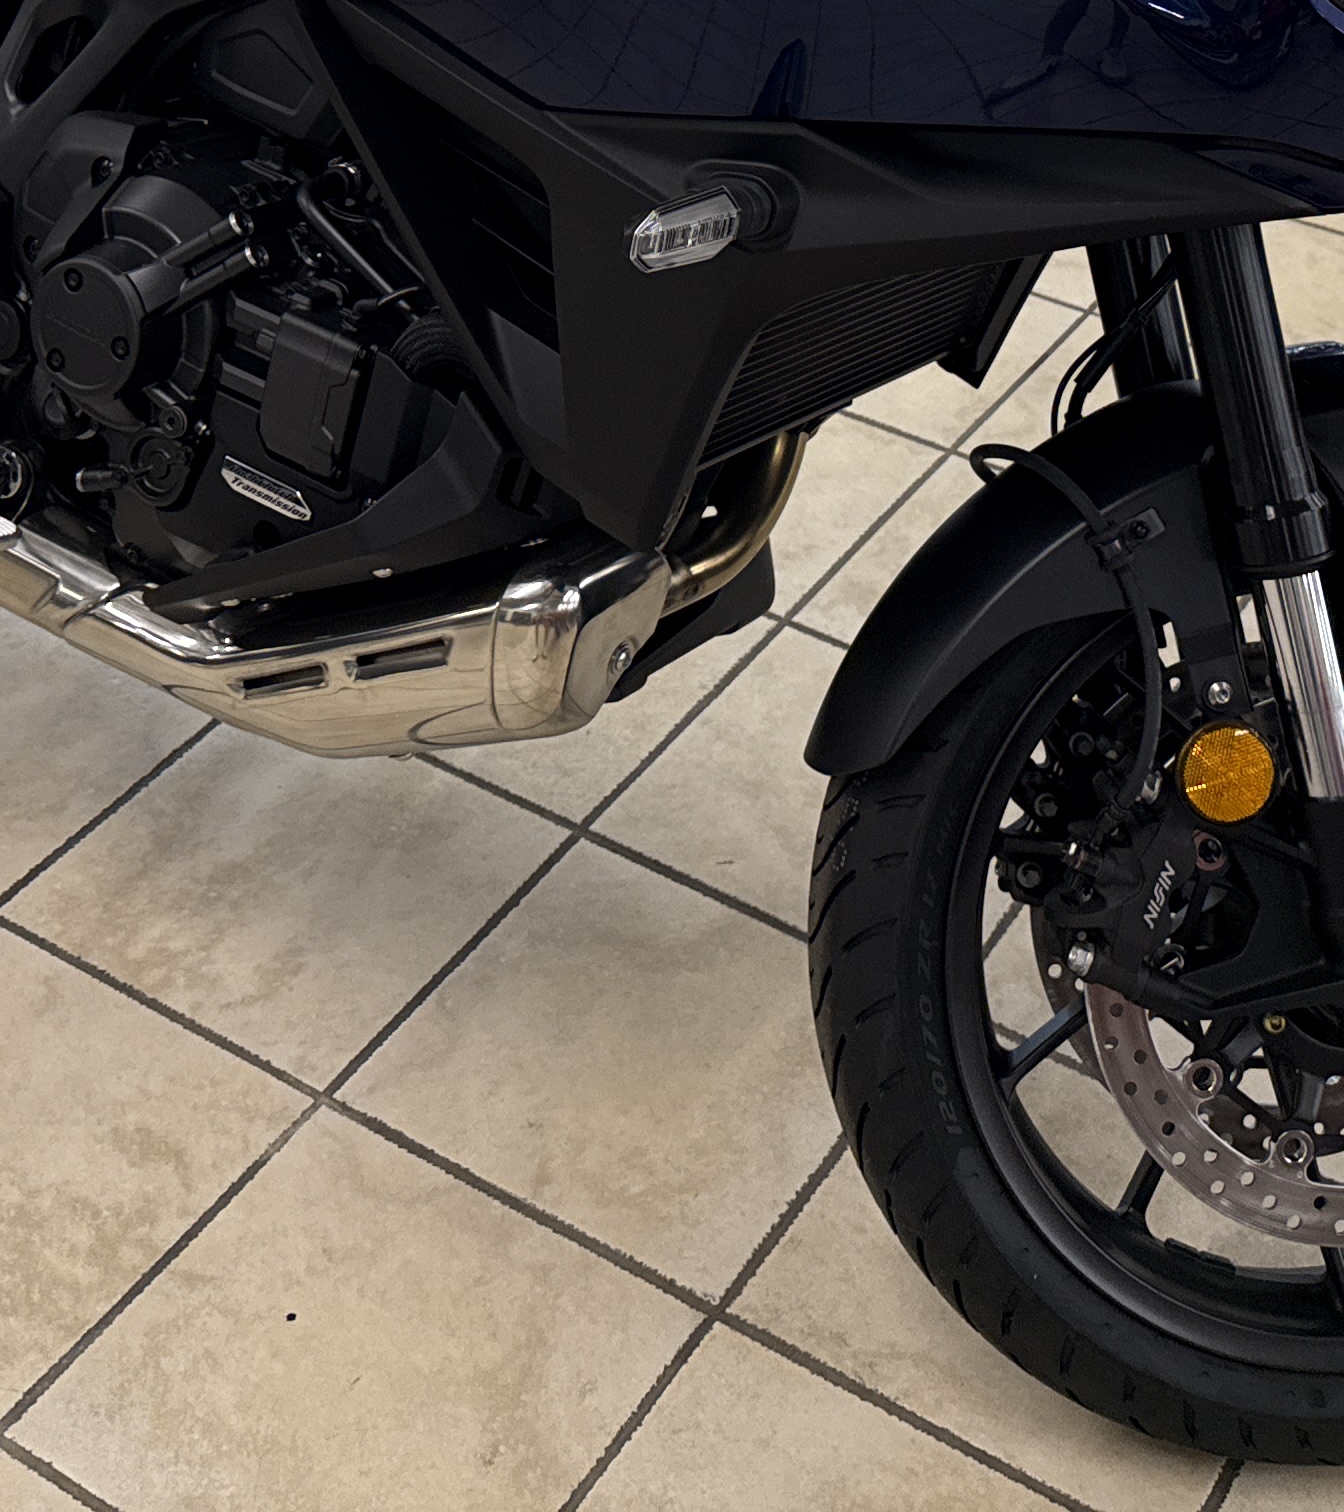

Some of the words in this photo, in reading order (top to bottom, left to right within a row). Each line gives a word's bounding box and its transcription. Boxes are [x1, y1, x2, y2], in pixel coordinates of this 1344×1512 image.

[231, 476, 308, 520] Transmission
[1143, 859, 1176, 930] NISSIN
[918, 919, 939, 981] ZR
[917, 994, 963, 1136] 120/70
